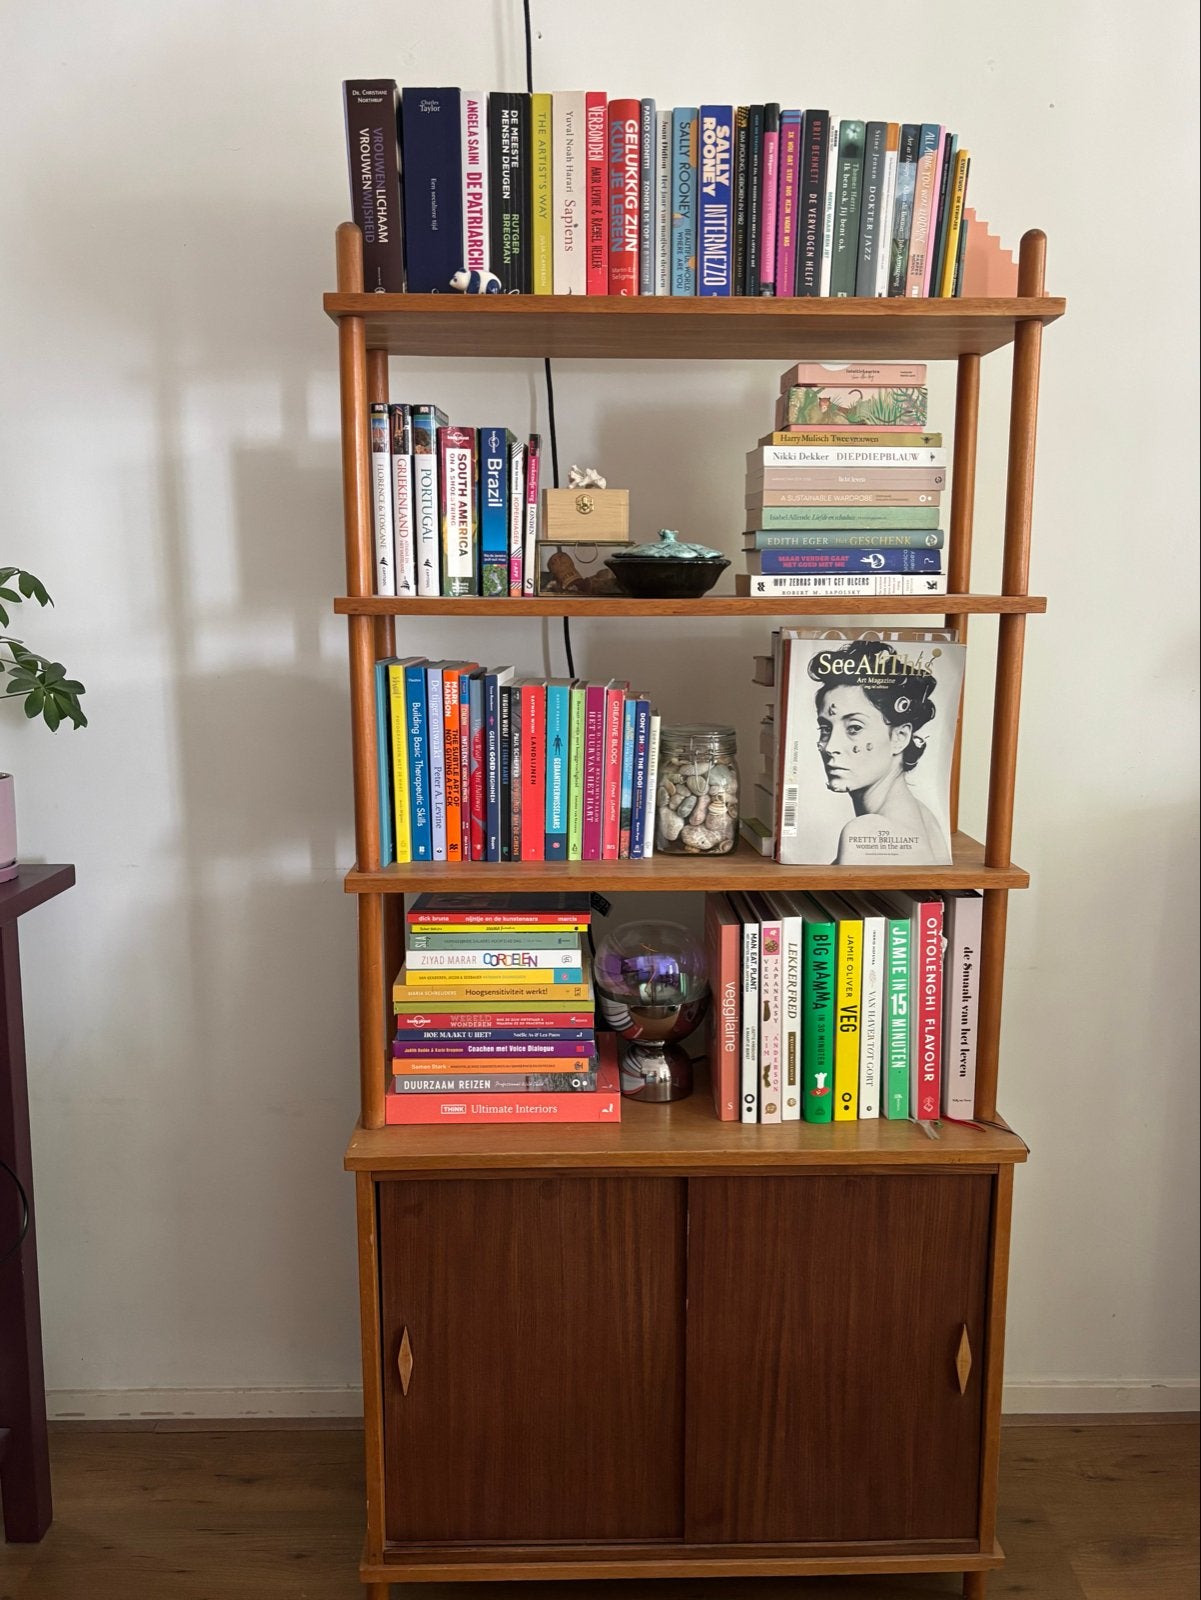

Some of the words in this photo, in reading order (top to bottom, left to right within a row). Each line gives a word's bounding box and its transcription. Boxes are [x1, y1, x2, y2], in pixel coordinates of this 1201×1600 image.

[420, 105, 441, 114] Taylor
[466, 100, 479, 137] ANGELA
[511, 110, 519, 124] DE
[538, 112, 547, 134] THE
[502, 110, 510, 154] MENSEN
[566, 111, 574, 136] Yuval
[588, 106, 605, 160] VERBONDEN
[812, 121, 822, 142] BRIT
[467, 139, 480, 165] SAINI
[511, 127, 519, 168] MEESTE
[566, 139, 574, 162] Noah
[611, 121, 624, 163] KUN
[679, 121, 691, 156] SALLY
[538, 139, 547, 189] ARTIST'S
[625, 120, 639, 209] GELUKKIG
[703, 117, 716, 197] ROONEY
[716, 125, 730, 186] SALLY
[810, 145, 821, 184] BENNETT
[844, 163, 850, 171] Ik
[871, 153, 879, 179] Jensen
[359, 128, 374, 243] VROUWENWIJSHEID
[373, 128, 389, 243] VROUWENLICHAAM
[466, 172, 482, 189] DE
[502, 156, 511, 199] DEUGEN
[566, 165, 574, 193] Harari
[611, 166, 624, 189] JE
[679, 162, 690, 219] ROONEY
[538, 194, 548, 219] WAY
[591, 185, 602, 207] LEVINE
[809, 193, 818, 204] DE
[867, 186, 877, 230] DOKTER
[560, 199, 579, 251] Sapiens
[611, 194, 624, 252] LEREN
[839, 206, 848, 217] Jij
[503, 214, 511, 263] BREGMAN
[511, 213, 520, 254] RUTGER
[625, 213, 639, 252] ZIJN
[703, 204, 728, 285] INTERMEZZO
[806, 208, 817, 258] VERVLOGEN
[591, 245, 603, 269] HELLER
[864, 234, 873, 261] JAZZ
[804, 261, 813, 287] HELFT
[772, 452, 797, 460] Nikki
[798, 452, 829, 460] Dekker
[836, 453, 920, 461] DIEPDIEPBLAUW
[457, 453, 468, 497] SOUTH
[487, 458, 504, 507] Brazil
[397, 458, 409, 538] GRIEKENLAND
[421, 468, 433, 543] PORTUGAL
[458, 500, 469, 557] AMERICA
[512, 496, 520, 545] KOPENHAGEN
[767, 537, 799, 545] EDITH
[802, 537, 829, 545] EGER
[849, 536, 912, 545] GESCHENK
[431, 680, 440, 691] De
[867, 677, 896, 685] Magazine
[411, 702, 422, 734] Building
[430, 693, 441, 717] tijger
[501, 693, 509, 718] VIRGINIA
[612, 701, 620, 737] CREATIVE
[413, 737, 424, 758] Basic
[431, 719, 440, 758] ontwaakt
[610, 738, 618, 765] BLOCK
[433, 766, 443, 787] Peter
[588, 756, 596, 773] VAN
[412, 760, 425, 805] Therapeutic
[435, 790, 443, 798] A.
[552, 757, 562, 829] GEDAANTEVERWISSELAARS
[587, 775, 595, 794] HET
[454, 796, 461, 807] OF
[586, 797, 594, 823] HART
[416, 808, 426, 827] Skills
[435, 802, 444, 829] Levine
[812, 934, 831, 955] BIG
[846, 934, 854, 962] JAMIE
[892, 927, 907, 974] JAMIE
[963, 947, 974, 960] de
[420, 955, 445, 965] ZIYAD
[447, 955, 477, 965] MARAR
[925, 917, 938, 1010] OTTOLENGHI
[465, 988, 523, 997] Hoogsensitiviteit
[525, 987, 548, 995] werkt!
[812, 960, 831, 1009] MAMMA
[846, 964, 854, 997] OLIVER
[892, 979, 907, 990] IN
[962, 962, 974, 1002] Smaak
[868, 991, 876, 1009] VAN
[891, 993, 907, 1015] 15
[723, 981, 739, 1051] veggilaine
[817, 1023, 825, 1033] 30
[818, 1013, 825, 1021] IN
[840, 1005, 857, 1032] VEG
[866, 1010, 875, 1040] HAVER
[961, 1005, 970, 1024] van
[467, 1045, 495, 1053] Coachen
[527, 1044, 555, 1053] Dialogue
[891, 1018, 907, 1068] MINUTEN
[924, 1018, 936, 1081] FLAVOUR
[960, 1028, 972, 1045] het
[817, 1035, 825, 1066] MINUTEN
[866, 1041, 874, 1060] TOT
[959, 1048, 971, 1077] leven
[403, 1080, 456, 1090] DUURZAAM
[459, 1080, 491, 1089] REIZEN
[865, 1062, 874, 1087] GORT
[471, 1104, 513, 1113] Ultimate
[514, 1104, 558, 1113] Interiors
